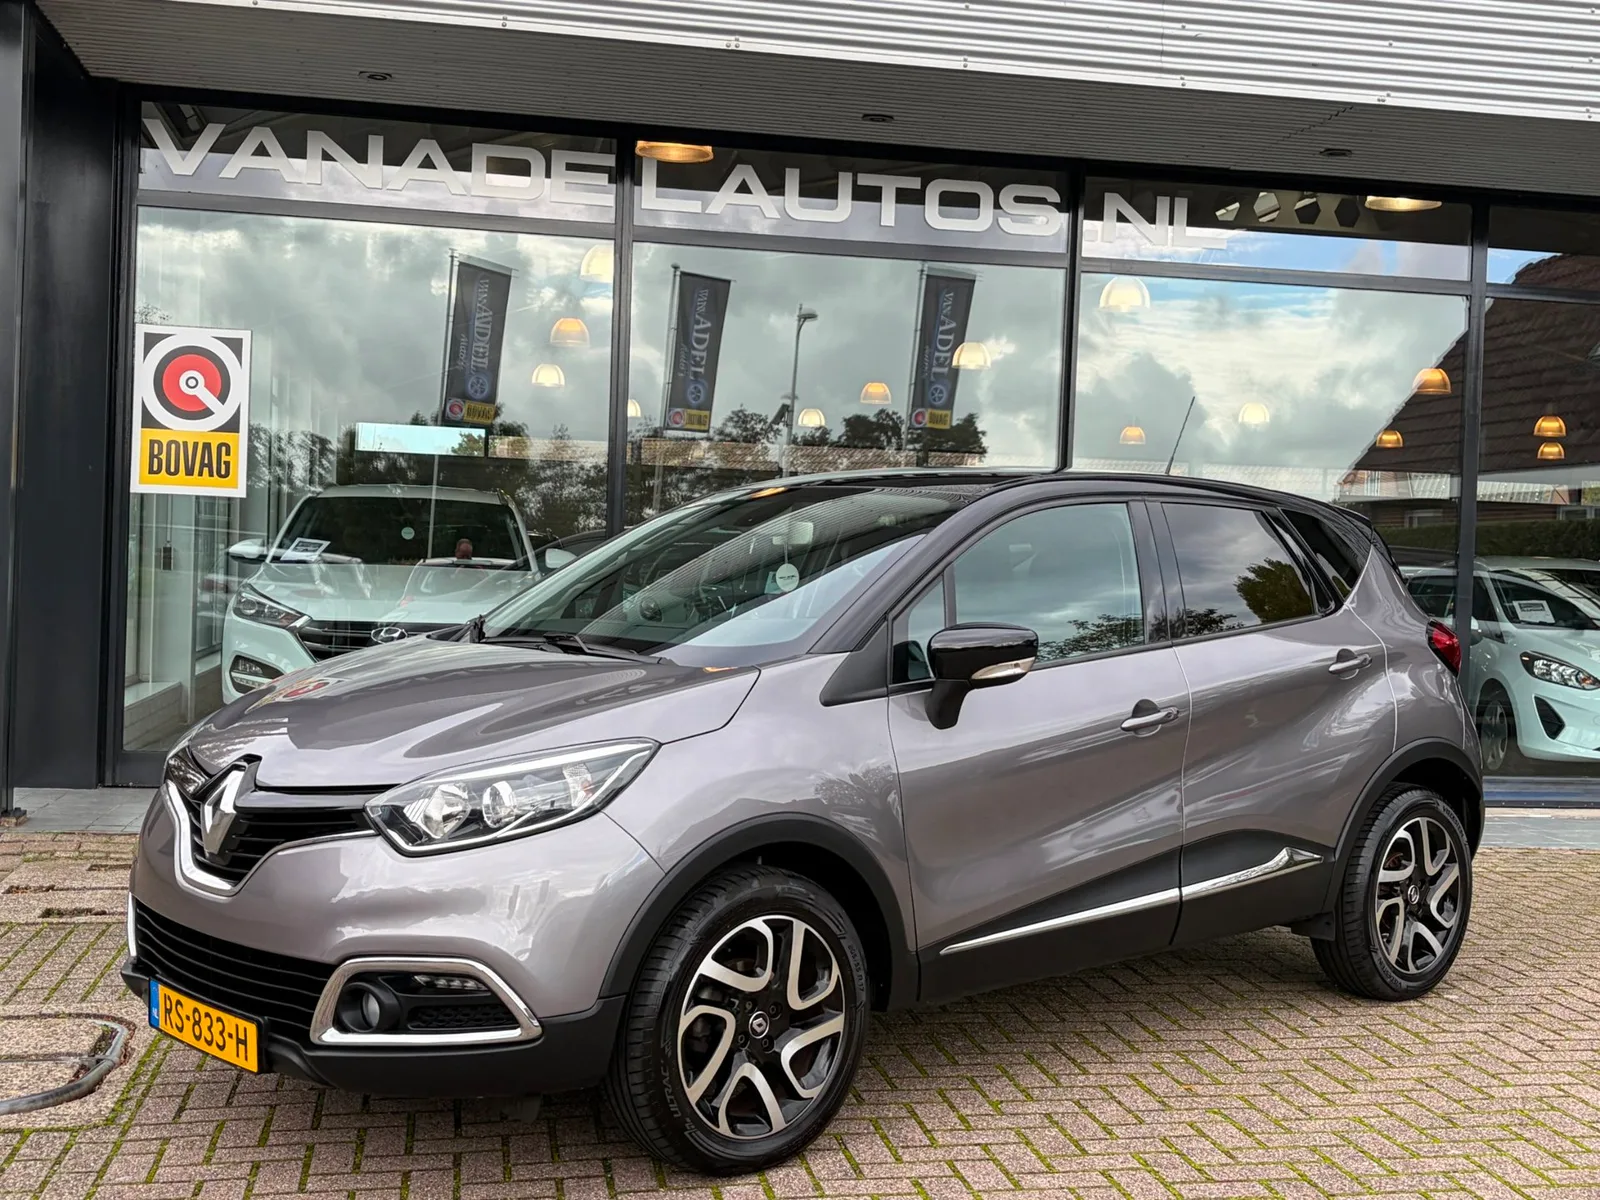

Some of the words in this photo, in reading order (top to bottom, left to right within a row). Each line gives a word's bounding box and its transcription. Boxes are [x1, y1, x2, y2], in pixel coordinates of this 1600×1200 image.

[689, 314, 712, 381] ADEL
[930, 314, 957, 382] ADEL
[148, 439, 231, 479] BOVAG
[164, 993, 248, 1062] RS-833-H
